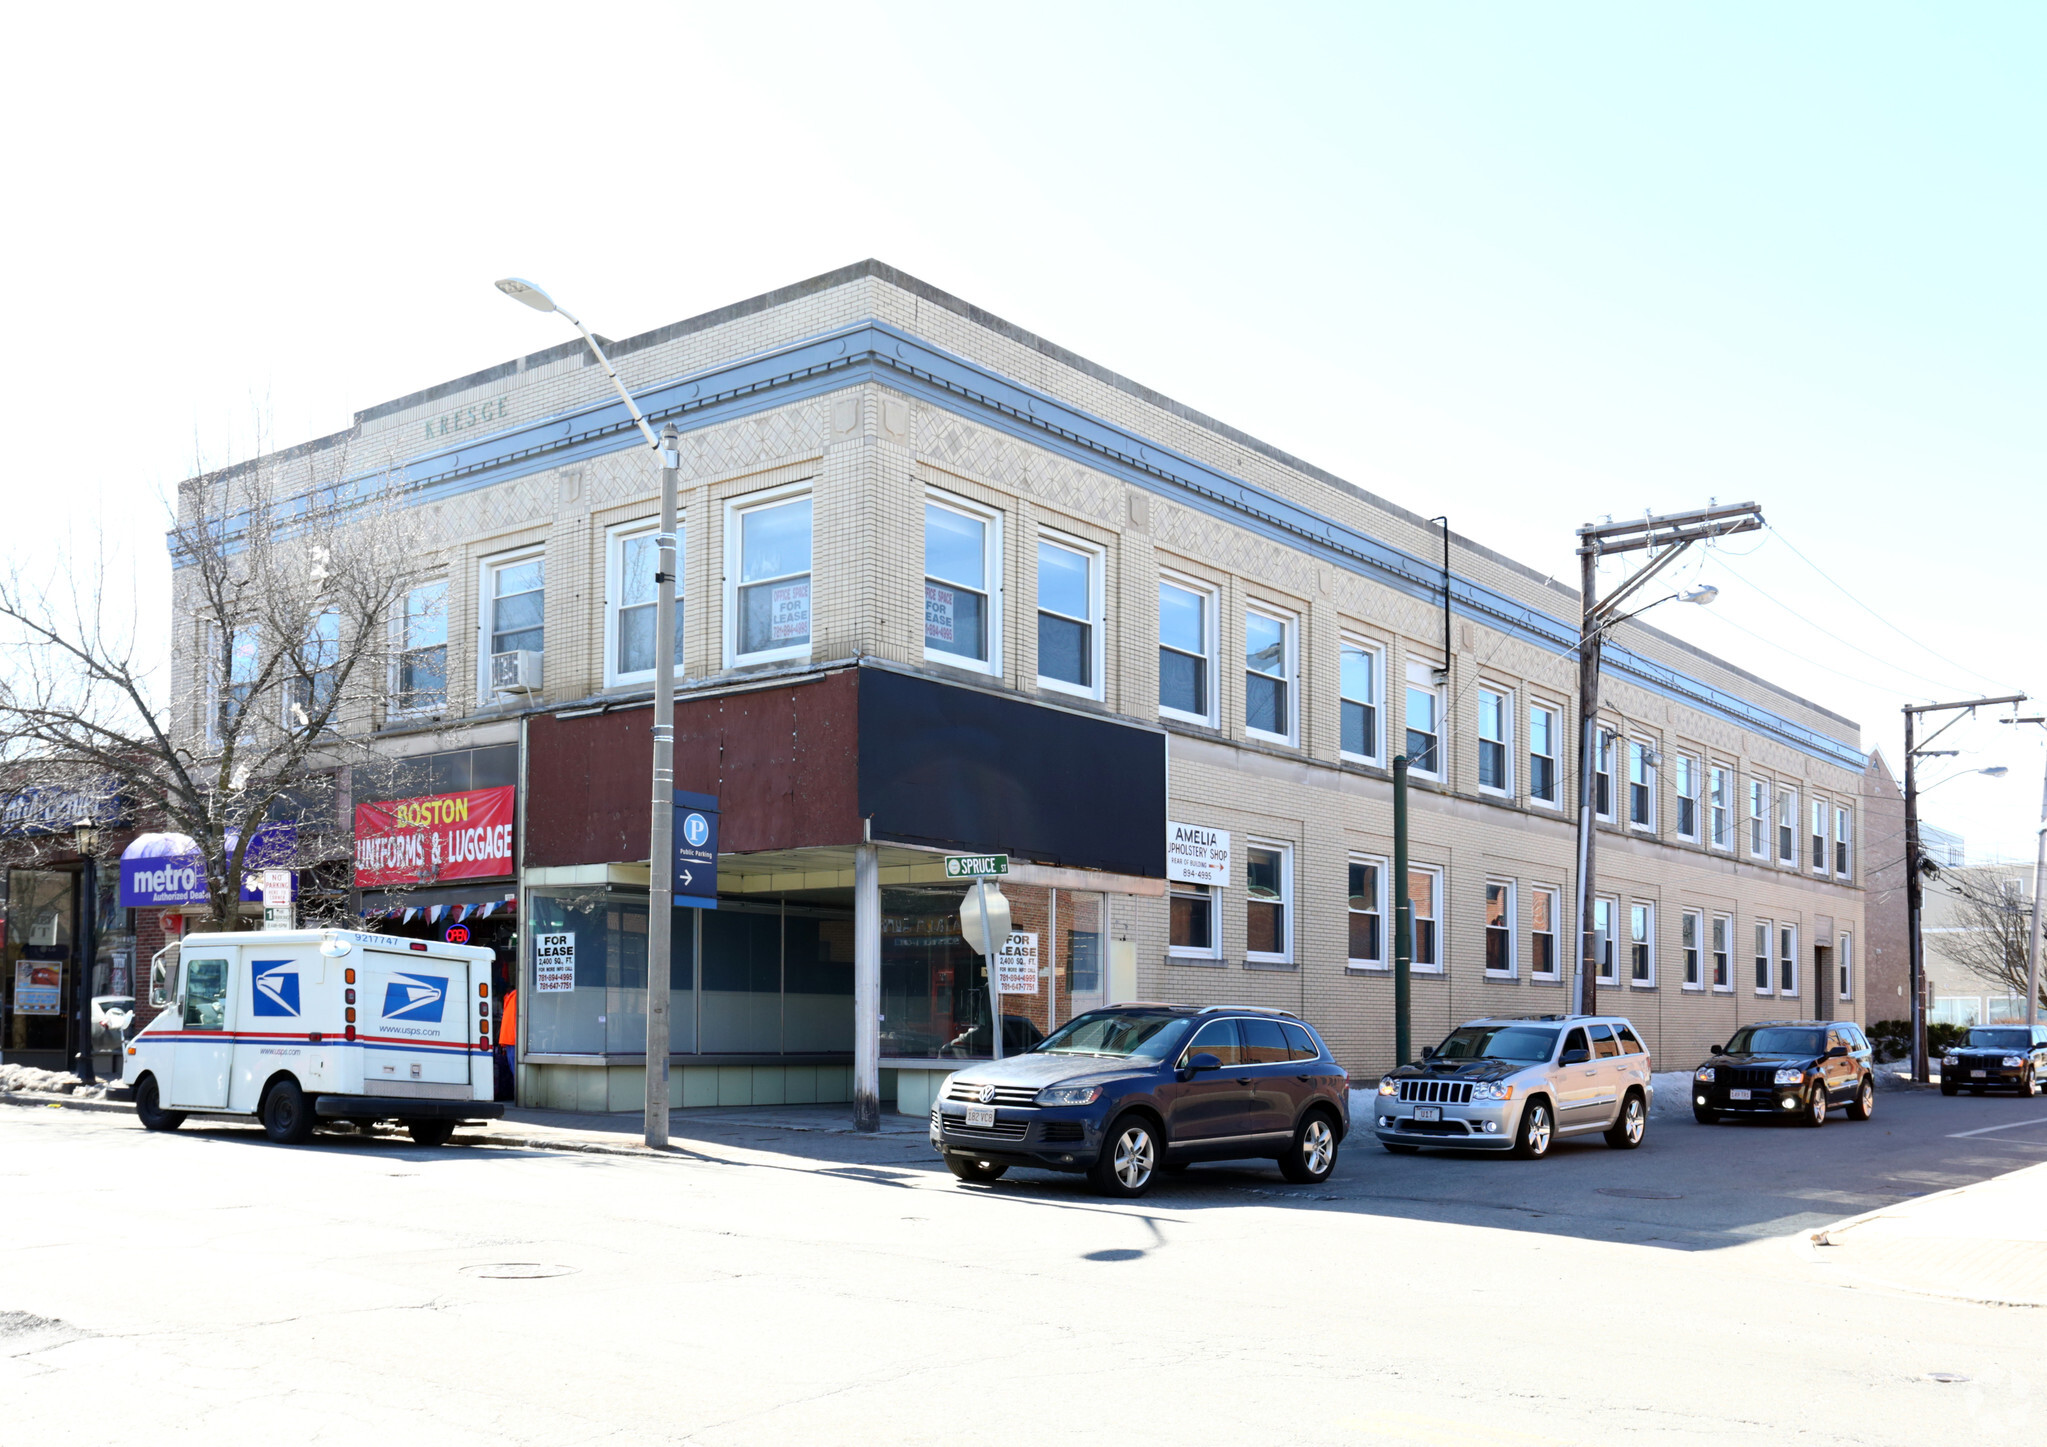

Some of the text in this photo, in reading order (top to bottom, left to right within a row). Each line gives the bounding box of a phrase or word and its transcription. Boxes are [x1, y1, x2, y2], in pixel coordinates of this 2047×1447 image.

[424, 396, 508, 440] KRESGE
[780, 600, 801, 612] FOR
[926, 600, 946, 615] FOR
[773, 610, 808, 625] LEASE
[925, 611, 952, 628] EASE
[397, 797, 468, 829] BOSTON
[1175, 827, 1217, 847] AMELIA
[356, 824, 512, 871] UNIFORMS & LUGGAGE
[680, 848, 712, 859] Public Parking
[1210, 848, 1228, 861] SHOP
[961, 858, 1006, 874] SPRUCE ST
[1171, 857, 1182, 865] REAR
[1190, 859, 1207, 868] BUILDING
[1183, 868, 1212, 880] 894-4995
[153, 891, 188, 902] Authorized
[354, 933, 398, 946] 9217747
[447, 928, 468, 942] OPEN
[1006, 935, 1029, 945] FOR
[544, 936, 567, 946] FOR
[538, 946, 574, 957] LEASE
[999, 946, 1036, 957] LEASE
[539, 957, 552, 966] 2,400
[1000, 957, 1014, 966] 2,400
[539, 973, 573, 982] 781-894-4995
[540, 982, 572, 990] 781-647-7751
[379, 1025, 441, 1036] www.usps.com
[260, 1048, 301, 1057] www.usps.com
[968, 1111, 993, 1122] 182 VC8
